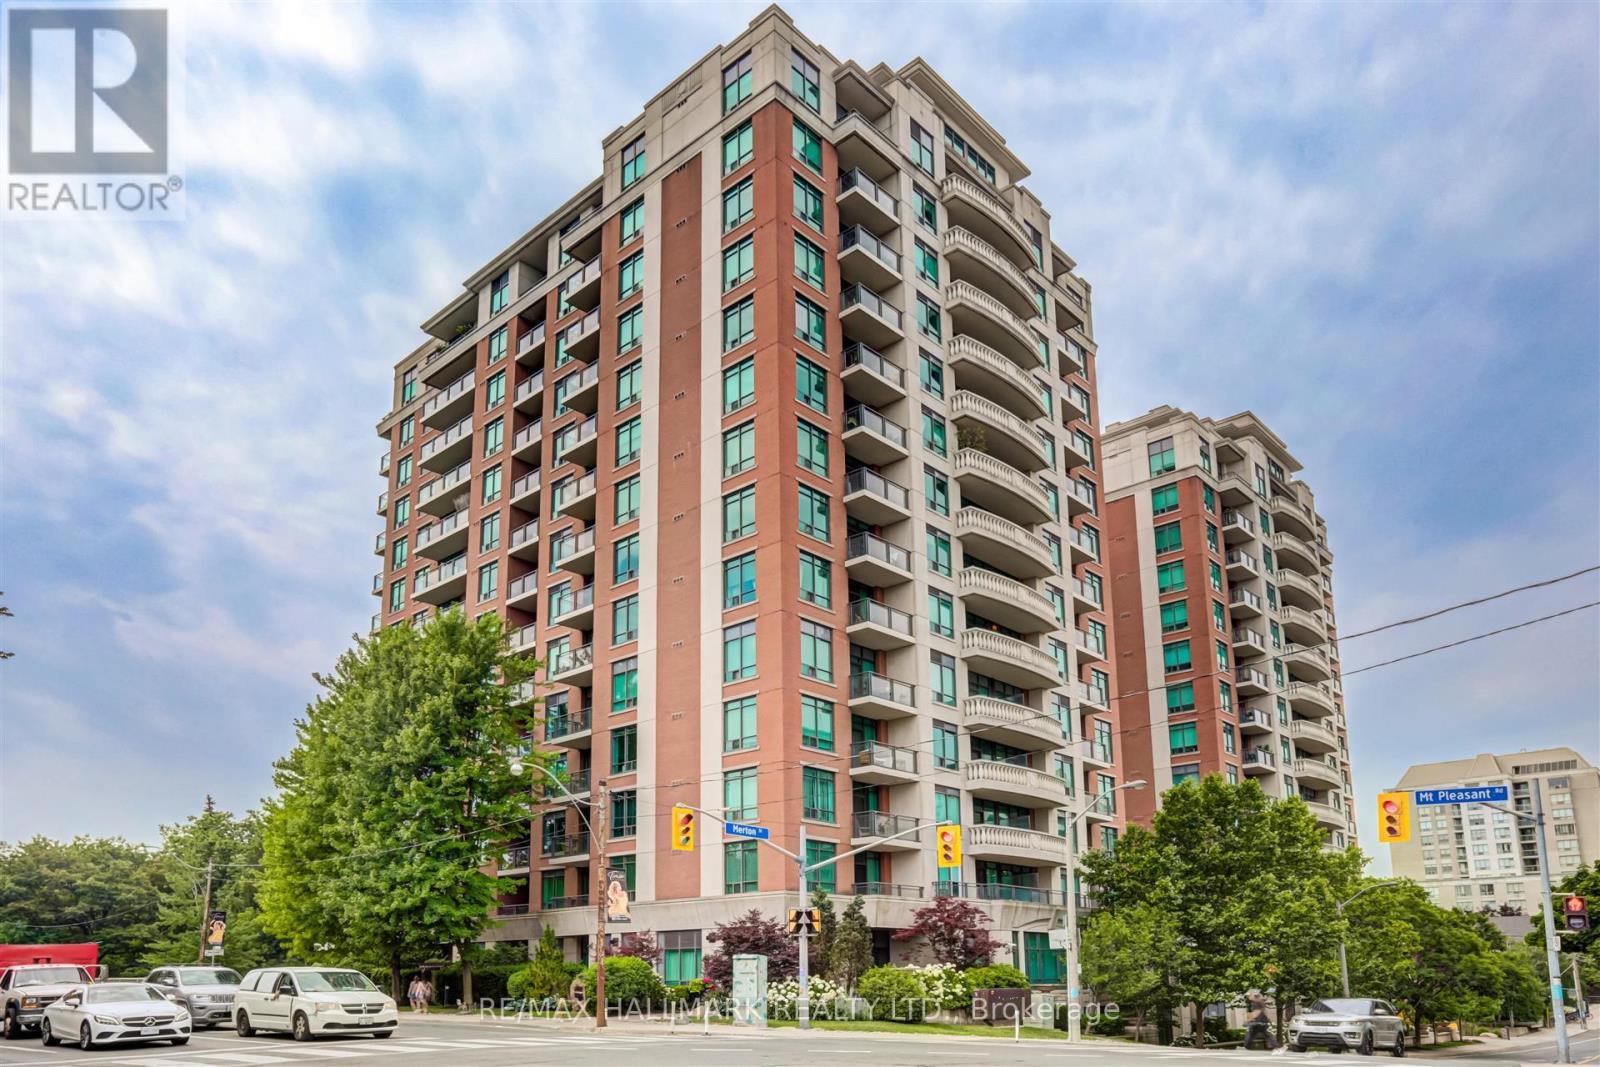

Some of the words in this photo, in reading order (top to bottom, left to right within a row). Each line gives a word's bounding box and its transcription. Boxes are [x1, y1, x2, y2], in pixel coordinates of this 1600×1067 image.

[1420, 792, 1433, 802] Mt
[1438, 788, 1491, 801] Pleasant
[732, 825, 757, 836] Merton
